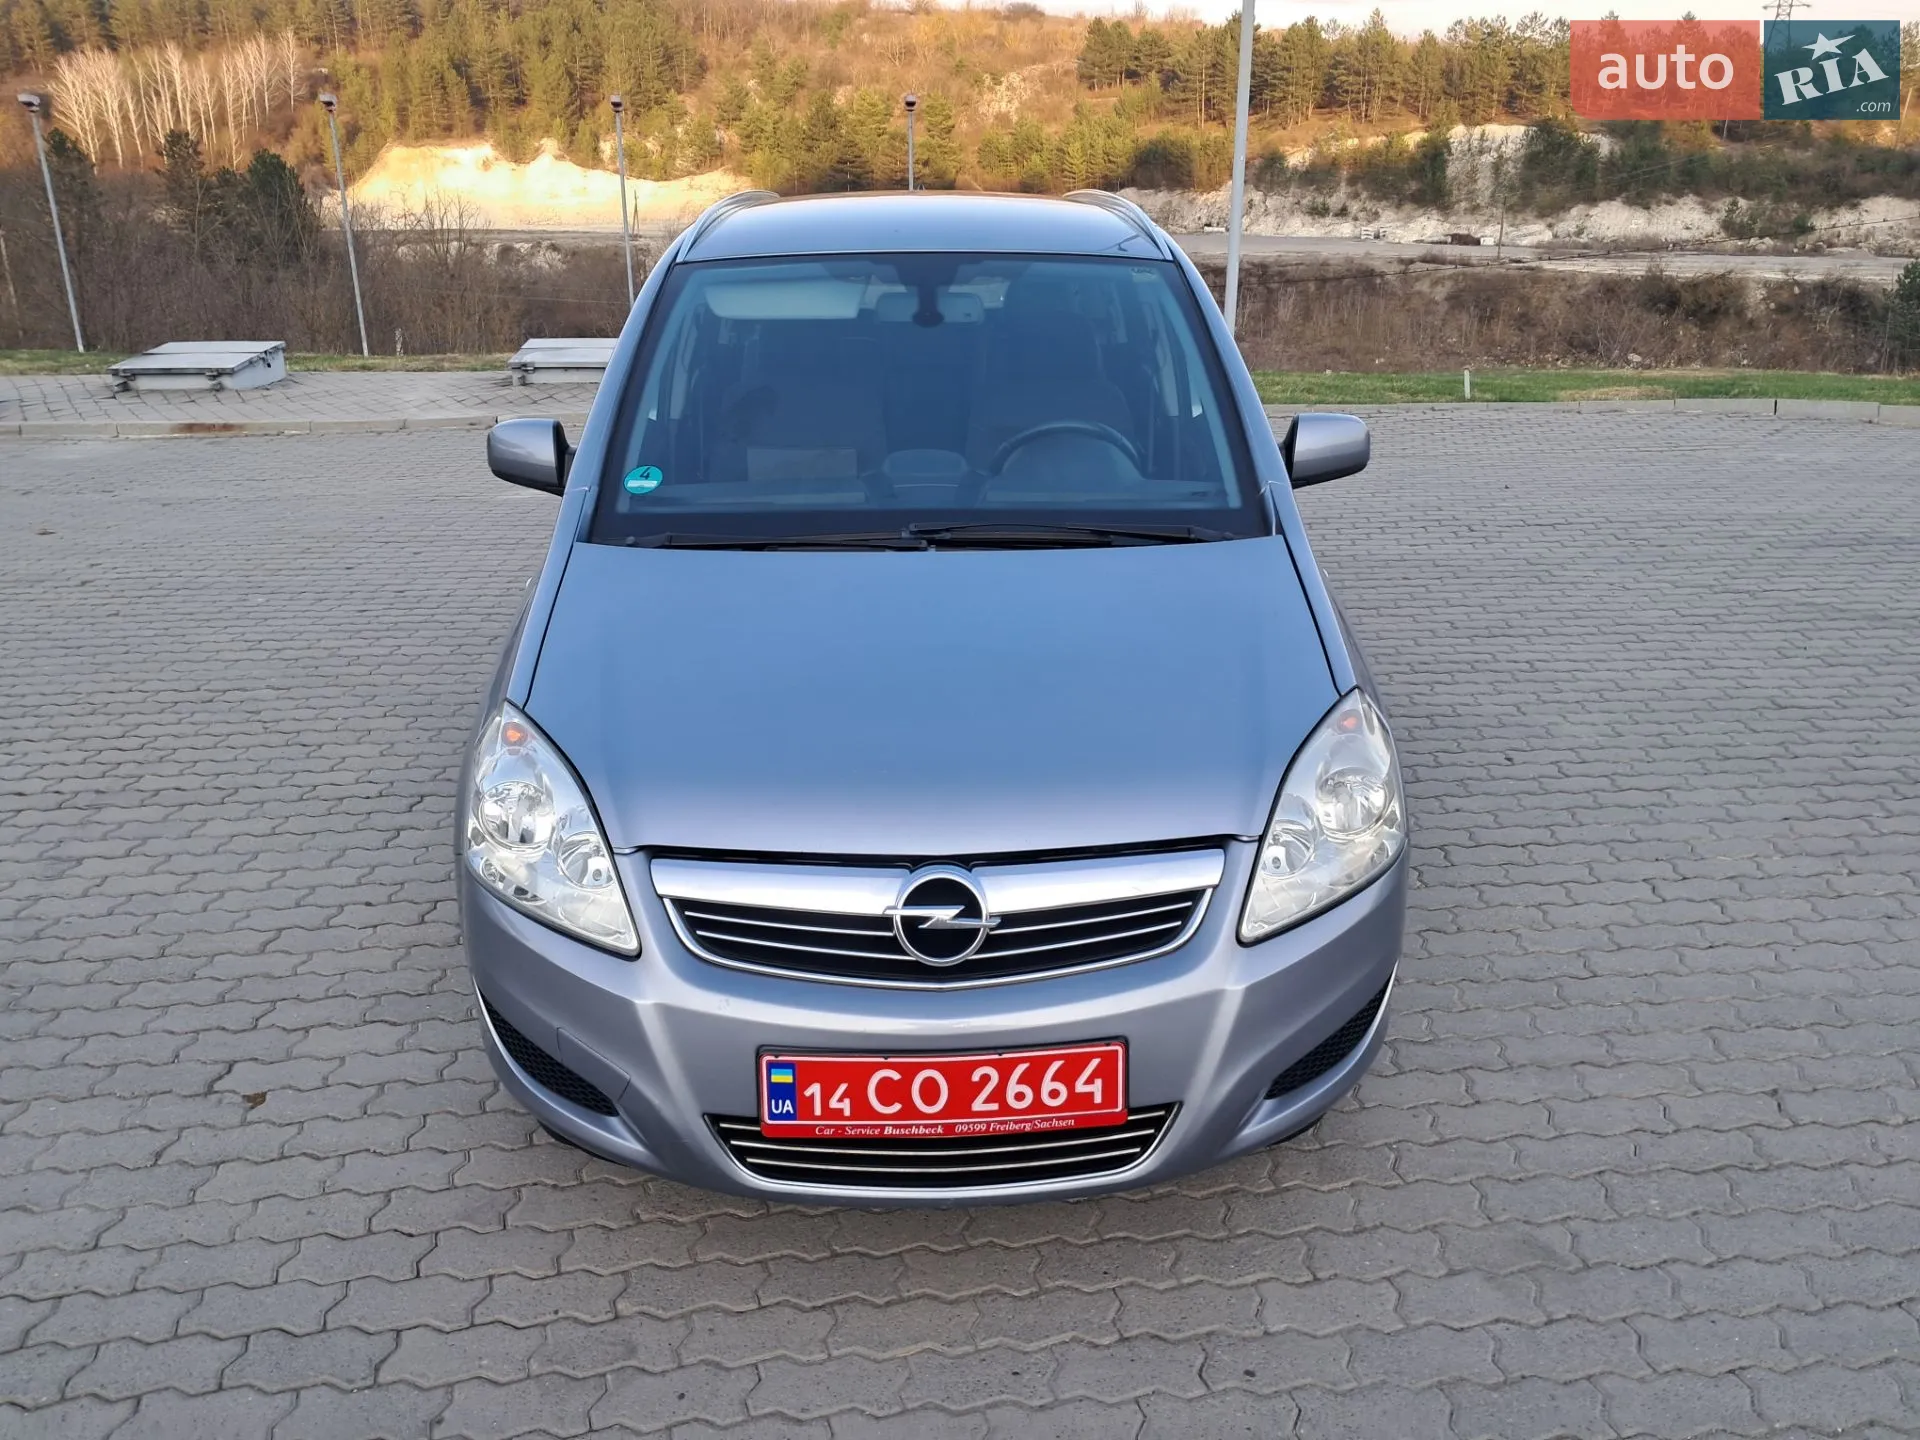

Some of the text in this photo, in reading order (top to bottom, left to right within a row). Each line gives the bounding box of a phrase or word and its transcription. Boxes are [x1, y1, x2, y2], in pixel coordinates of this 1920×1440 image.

[640, 466, 651, 480] 4
[803, 1058, 1102, 1116] 14 CO 2664
[771, 1099, 794, 1114] UA
[815, 1126, 835, 1135] Car
[845, 1126, 880, 1135] Service
[884, 1125, 944, 1135] Buschbeck
[955, 1123, 987, 1133] 09599
[989, 1118, 1075, 1132] Freiberg/Sachsen
